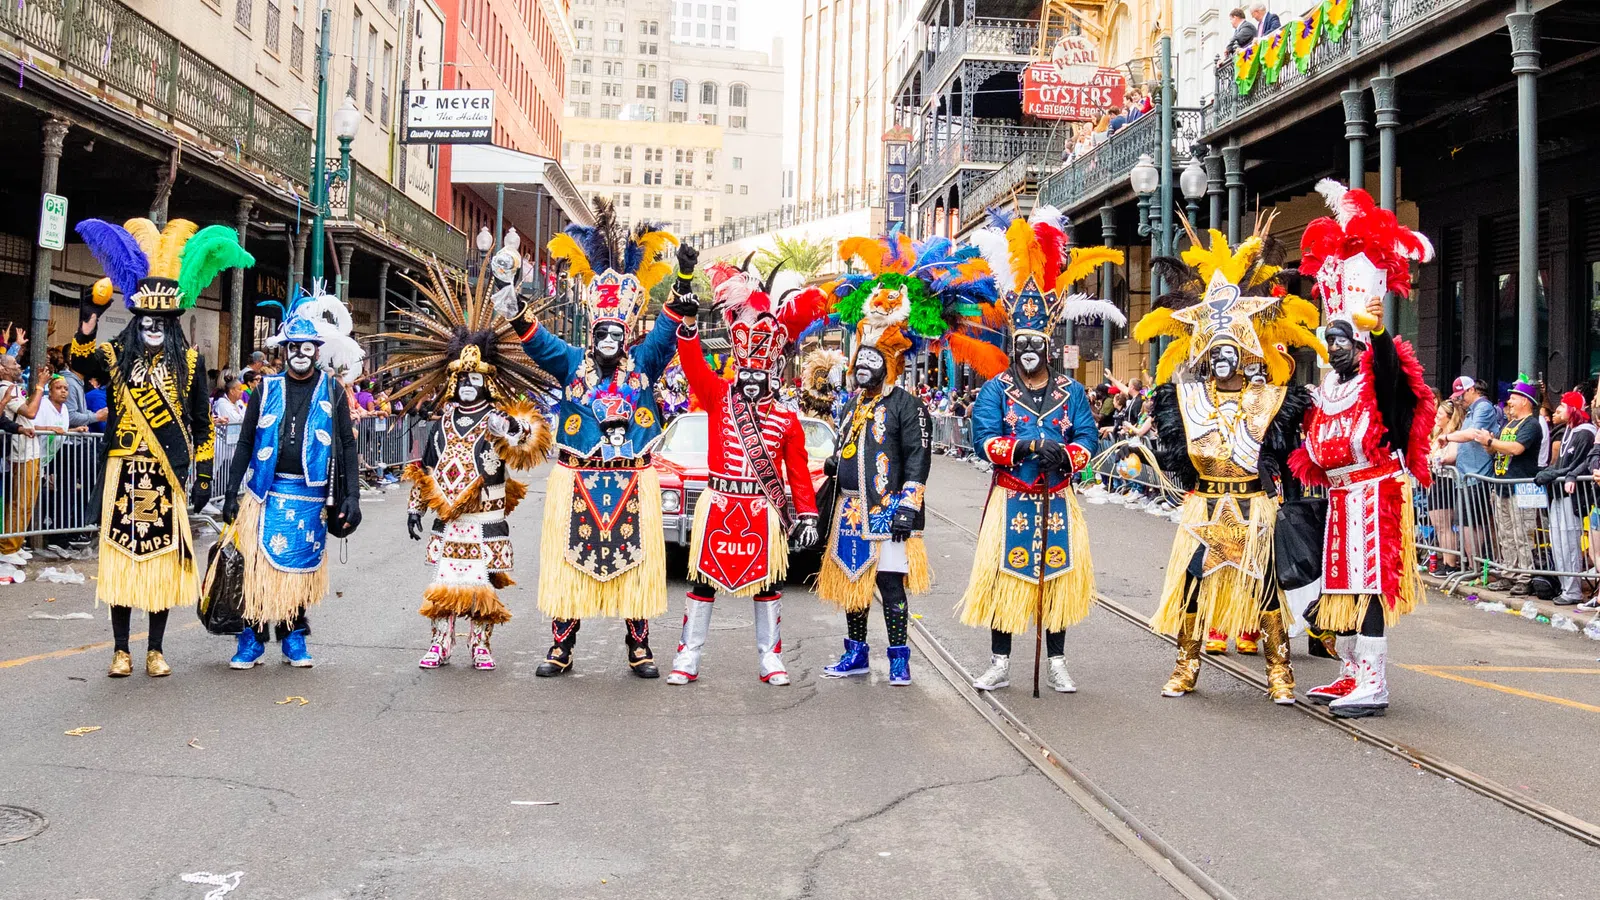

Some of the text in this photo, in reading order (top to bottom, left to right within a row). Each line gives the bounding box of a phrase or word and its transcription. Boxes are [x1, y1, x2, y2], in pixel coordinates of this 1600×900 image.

[1058, 39, 1085, 52] The
[1054, 49, 1099, 70] PEARL
[1031, 70, 1121, 88] RESANT
[436, 97, 490, 109] MEYER
[1039, 84, 1112, 107] OYSTERS
[436, 112, 488, 121] The Hatter
[410, 130, 488, 139] Quality Hats Since 1894
[129, 382, 173, 429] ZULU
[916, 406, 929, 449] ZULU
[1206, 482, 1248, 494] ZULU
[599, 475, 613, 578] TRAMPS
[1330, 495, 1341, 579] TRAMPS
[112, 527, 172, 554] TRAMPS
[715, 541, 756, 556] ZULU
[1031, 501, 1043, 578] TRAMPS
